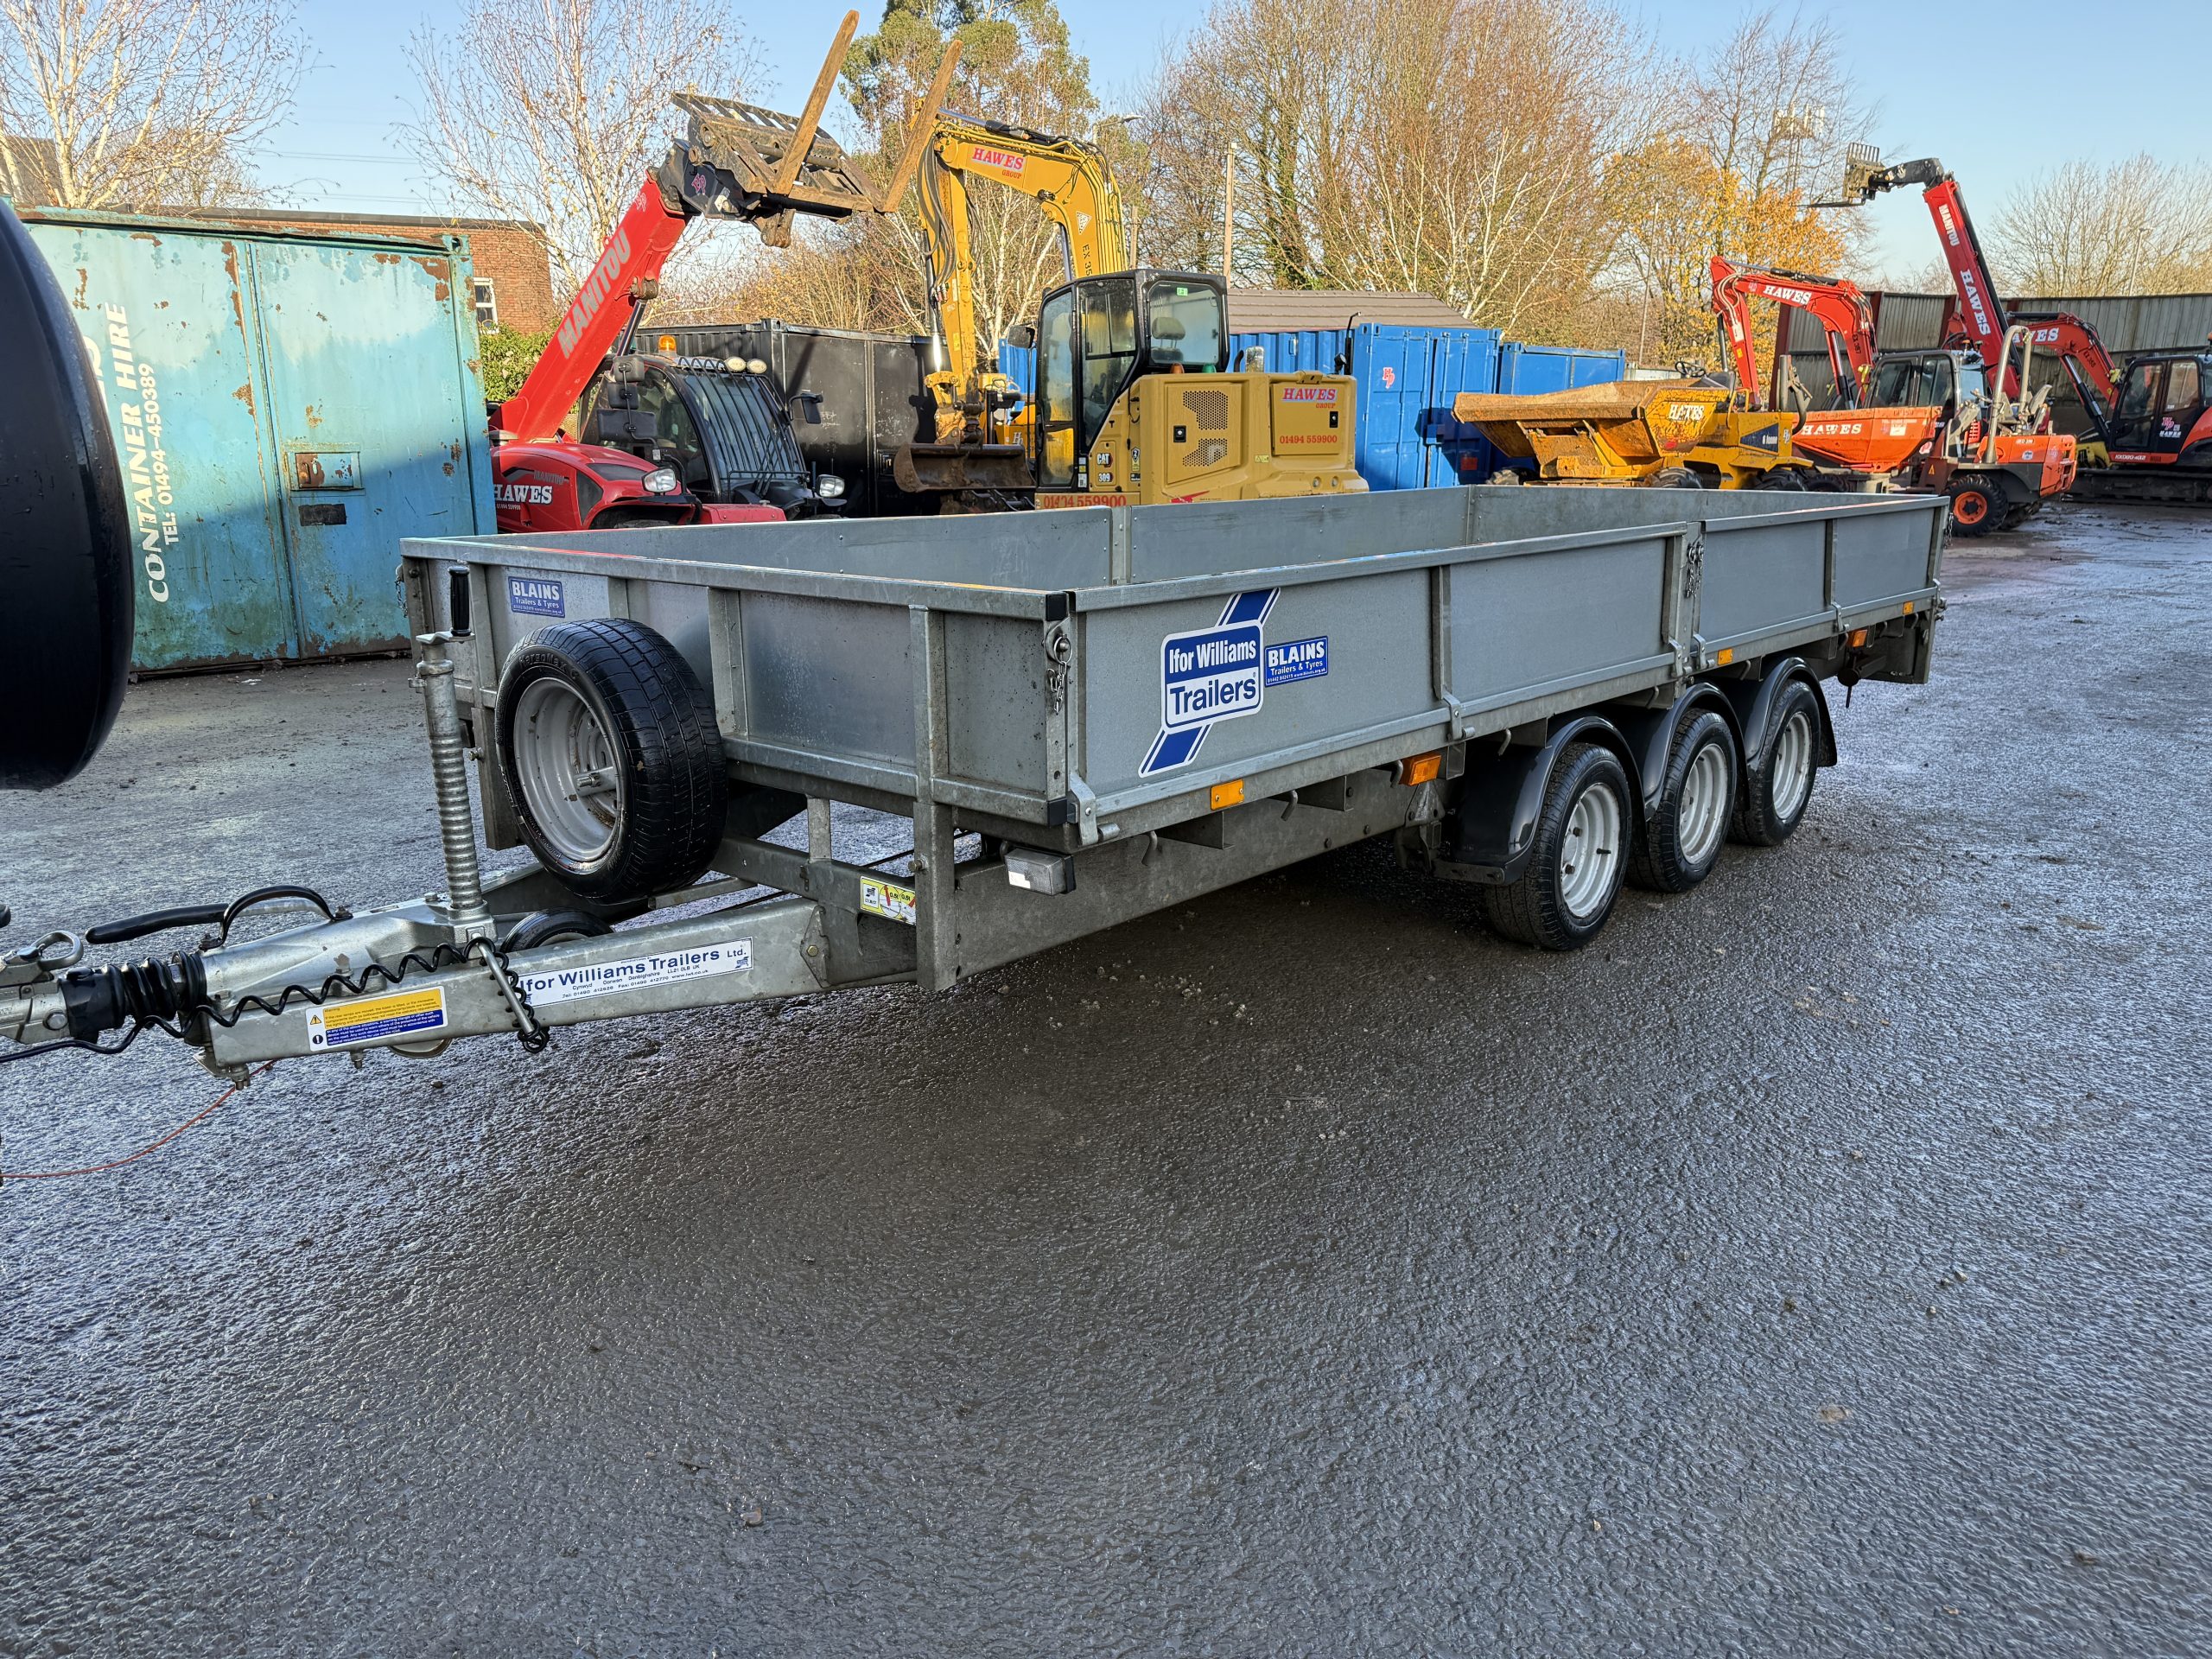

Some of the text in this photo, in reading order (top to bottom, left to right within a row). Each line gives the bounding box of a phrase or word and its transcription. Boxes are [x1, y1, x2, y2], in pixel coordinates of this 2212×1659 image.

[972, 147, 1024, 170] HAWES
[1001, 169, 1022, 179] GROUP
[1938, 204, 1960, 246] MANITOU
[1082, 244, 1090, 259] EX
[557, 228, 632, 359] MANITOU
[1763, 284, 1813, 306] HAWES
[1960, 269, 1992, 336] HAWES
[1282, 388, 1338, 401] HAWES
[1280, 435, 1304, 444] 01494
[1802, 423, 1863, 436] HAWES
[105, 302, 169, 602] CONTAINER HIRE
[137, 363, 180, 546] TEL: 01494-450389
[1096, 453, 1110, 465] CAT
[1098, 474, 1110, 482] 309
[494, 484, 553, 505] HAWES
[512, 581, 560, 601] BLAINS
[515, 596, 537, 606] Trailers
[543, 600, 560, 608] Tyres
[1169, 639, 1256, 674] Ifor Williams
[1268, 641, 1325, 668] BLAINS
[1270, 665, 1296, 676] Trailers
[1305, 660, 1323, 671] Tyres
[1169, 678, 1256, 715] Trailers
[519, 977, 555, 993] Ifor
[558, 963, 645, 986] Williams
[648, 950, 721, 971] Trailers
[727, 948, 747, 958] Ltd.
